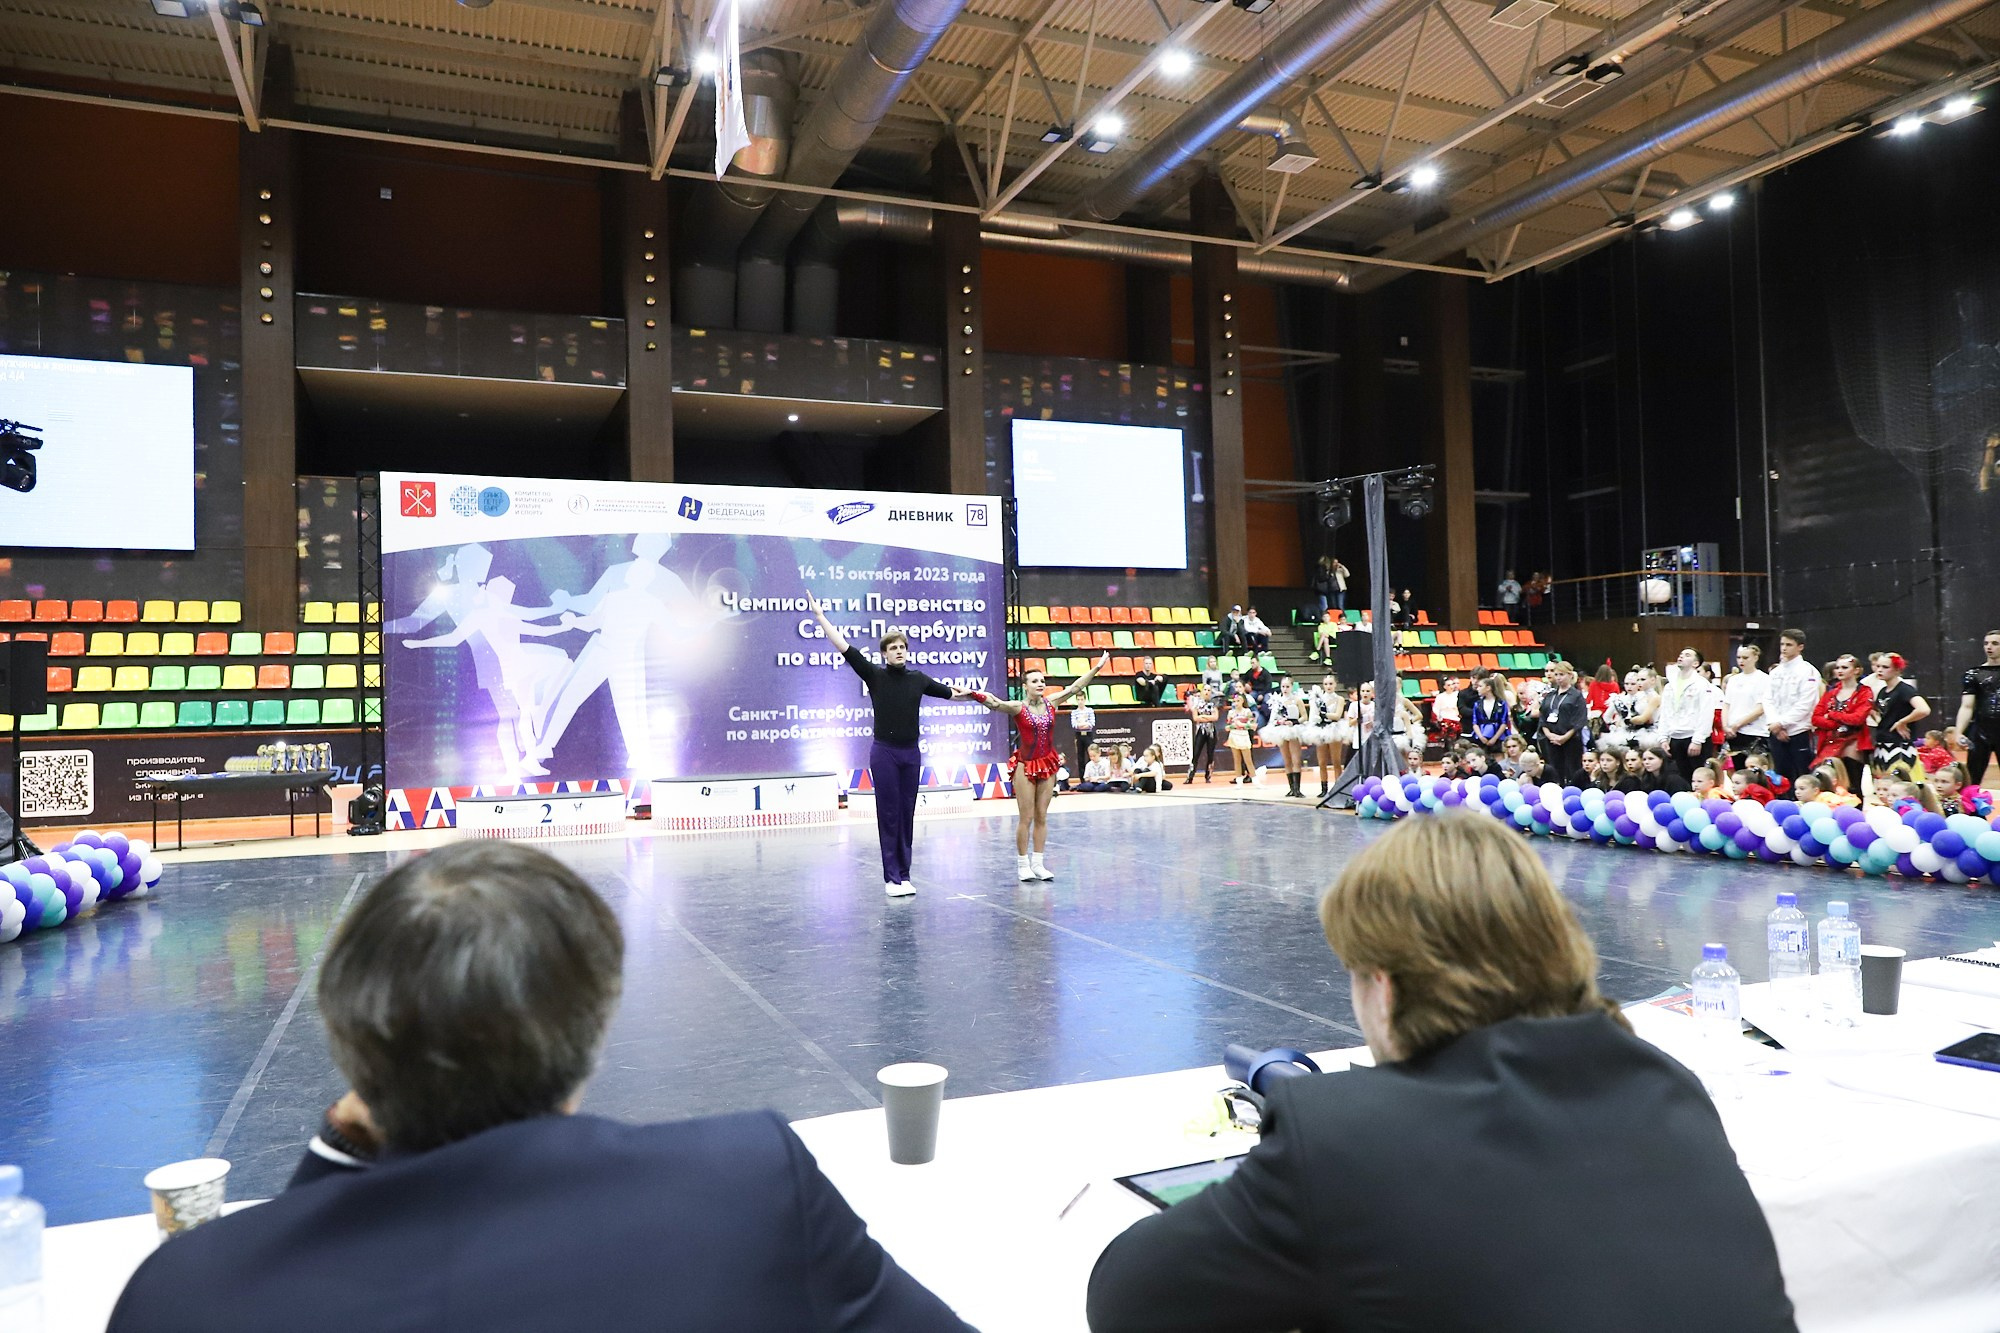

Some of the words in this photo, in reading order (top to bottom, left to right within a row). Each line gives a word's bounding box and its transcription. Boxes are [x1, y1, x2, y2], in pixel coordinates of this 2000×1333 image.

[707, 508, 765, 517] ФЕДЕРАЦИЯ
[888, 510, 954, 522] ДНЕВНИК
[969, 508, 984, 521] 78
[798, 565, 817, 580] 14
[828, 566, 844, 580] 15
[848, 567, 911, 584] октября
[914, 567, 949, 582] 2023
[953, 571, 985, 584] года
[848, 599, 860, 611] и
[866, 593, 986, 616] Первенство
[777, 652, 804, 666] по
[808, 646, 988, 669] акрбаческому
[728, 704, 875, 723] Санкт-Петербург
[726, 728, 747, 741] по
[751, 724, 875, 743] акробатическо
[126, 756, 206, 767] производитель
[135, 766, 197, 778] спортивной
[128, 794, 142, 802] из
[752, 784, 763, 811] 1
[540, 803, 553, 824] 2
